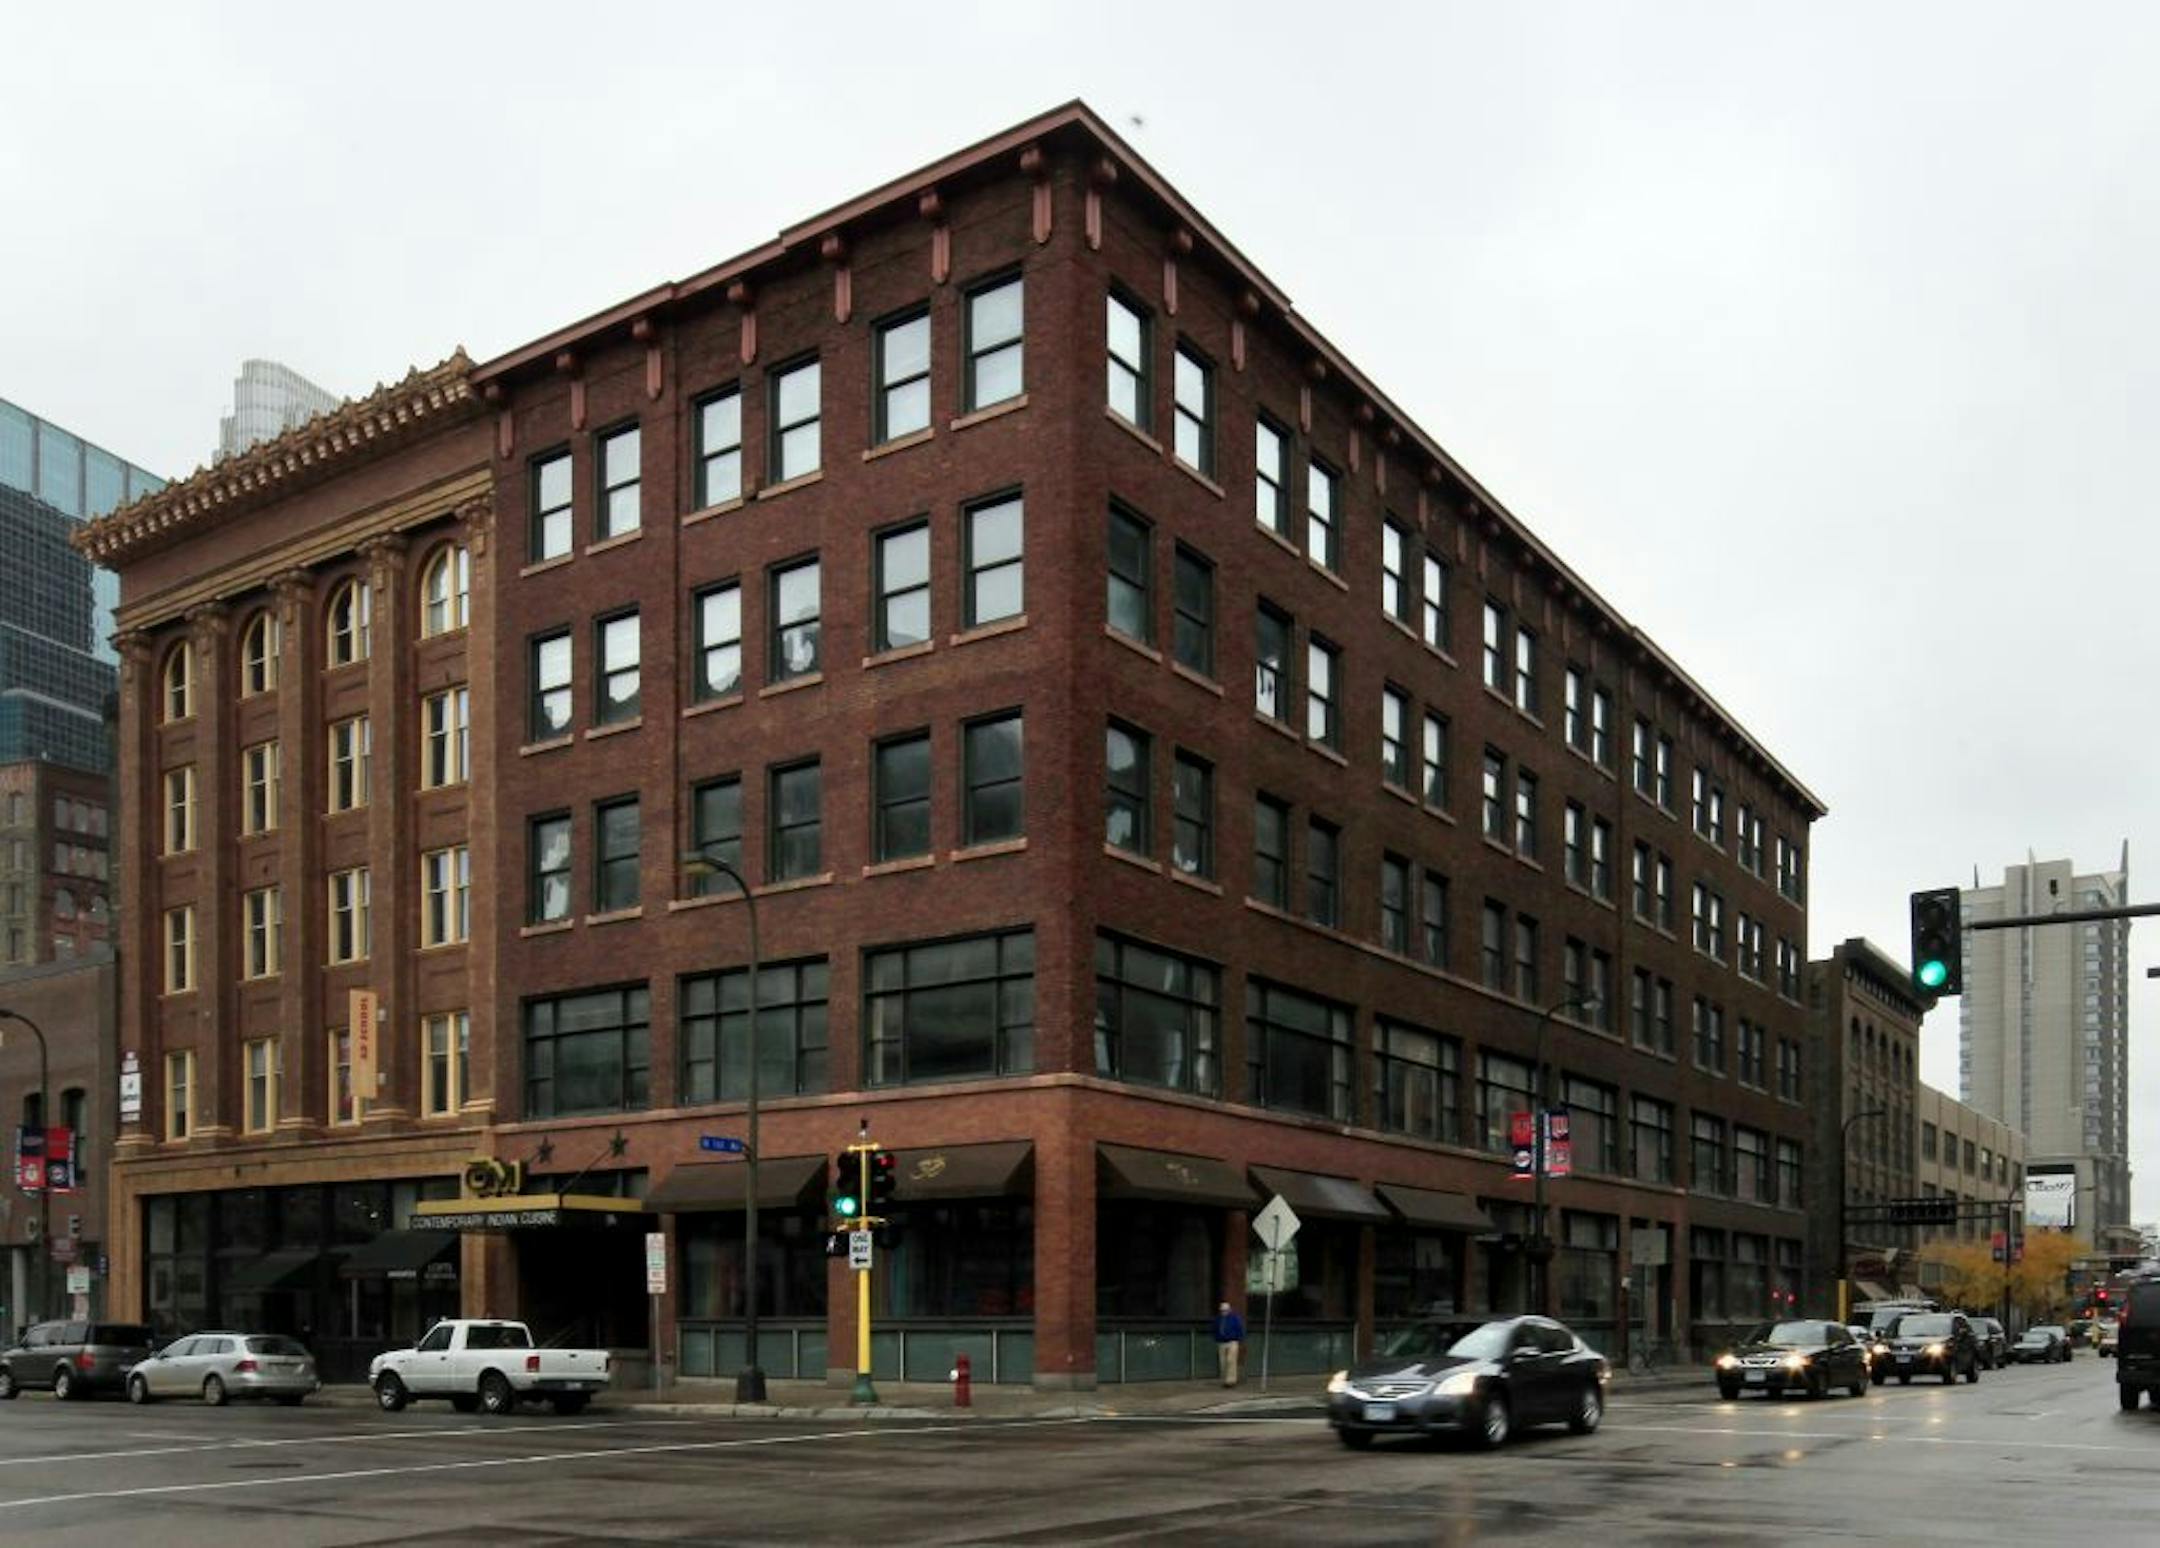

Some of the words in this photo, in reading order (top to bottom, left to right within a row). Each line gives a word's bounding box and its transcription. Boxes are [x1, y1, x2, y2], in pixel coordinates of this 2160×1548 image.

[411, 1214, 484, 1230] CONTEMPORARY
[486, 1212, 518, 1227] INDIAN
[520, 1209, 557, 1226] CUISINE
[851, 1233, 868, 1243] ONE
[851, 1244, 868, 1254] WAY
